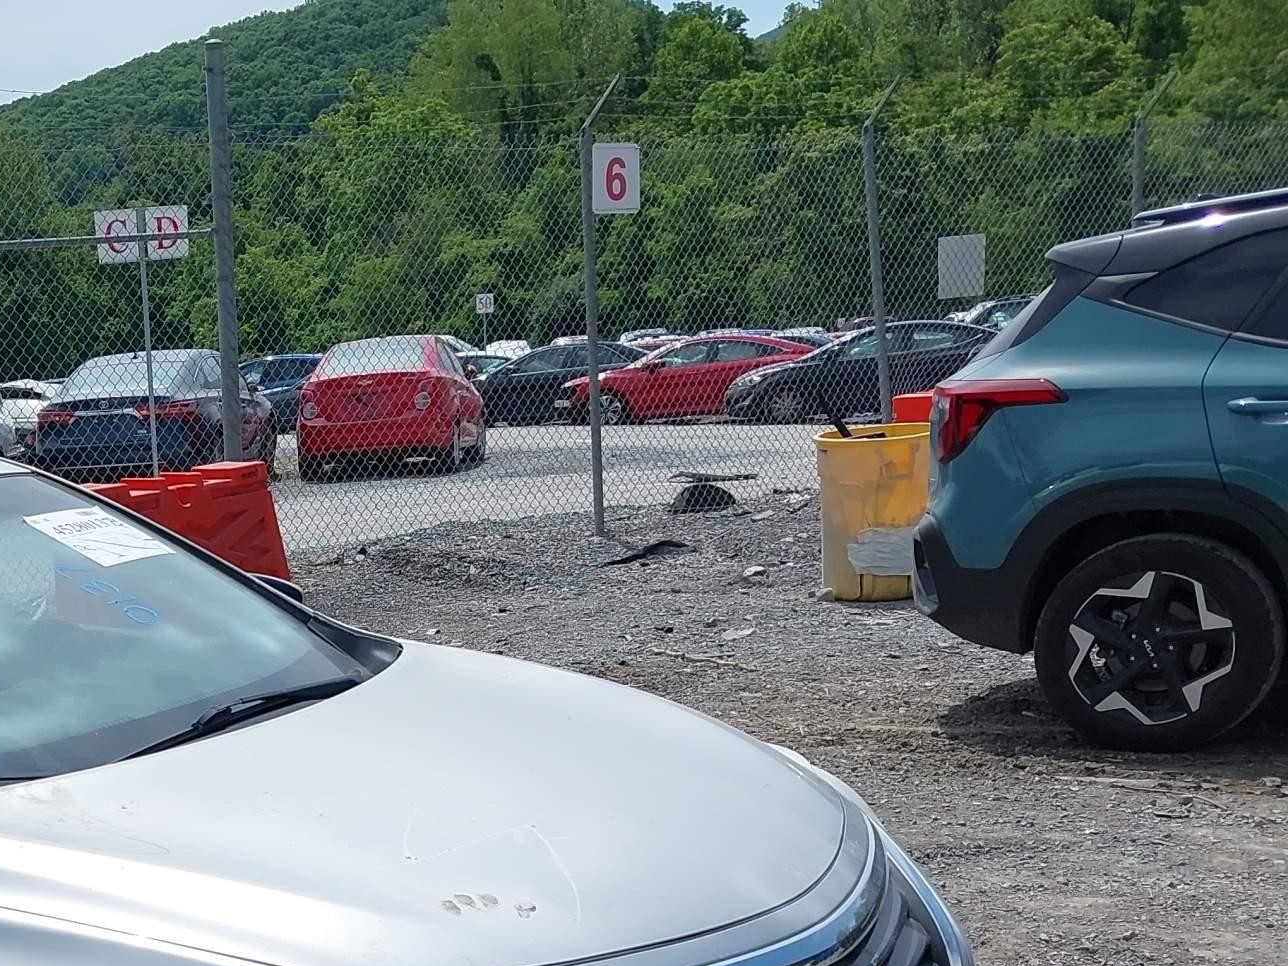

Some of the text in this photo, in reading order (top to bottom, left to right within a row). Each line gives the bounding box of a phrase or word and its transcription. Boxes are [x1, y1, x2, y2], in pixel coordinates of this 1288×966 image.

[606, 157, 627, 201] 6
[105, 219, 130, 254] C
[153, 216, 179, 250] D
